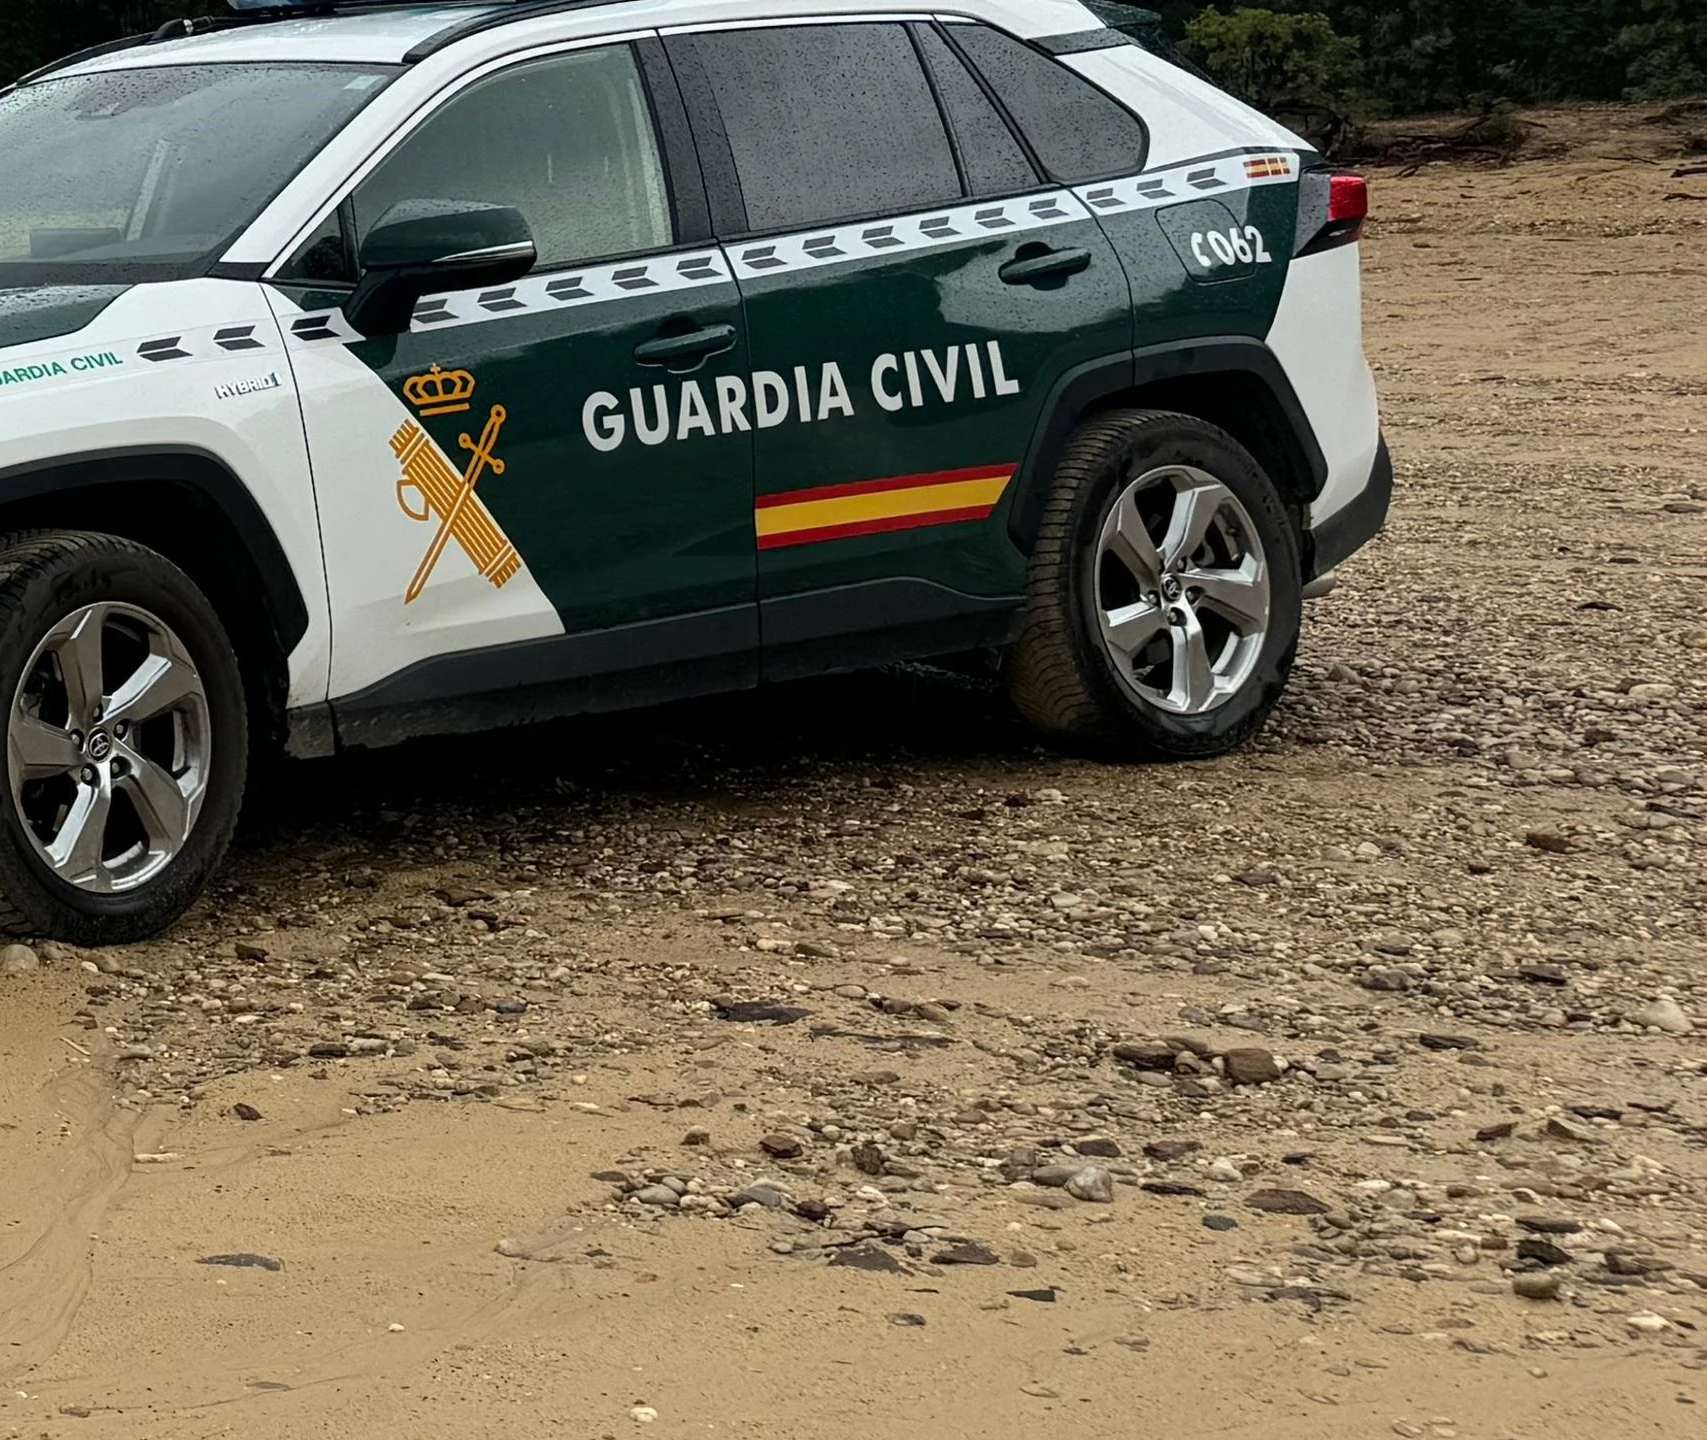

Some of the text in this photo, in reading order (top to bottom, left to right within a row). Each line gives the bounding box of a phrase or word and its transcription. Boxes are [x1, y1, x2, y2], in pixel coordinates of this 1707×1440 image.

[1206, 225, 1273, 266] 062
[70, 351, 124, 371] CIVIL
[582, 340, 1020, 452] GUARDIA CIVIL
